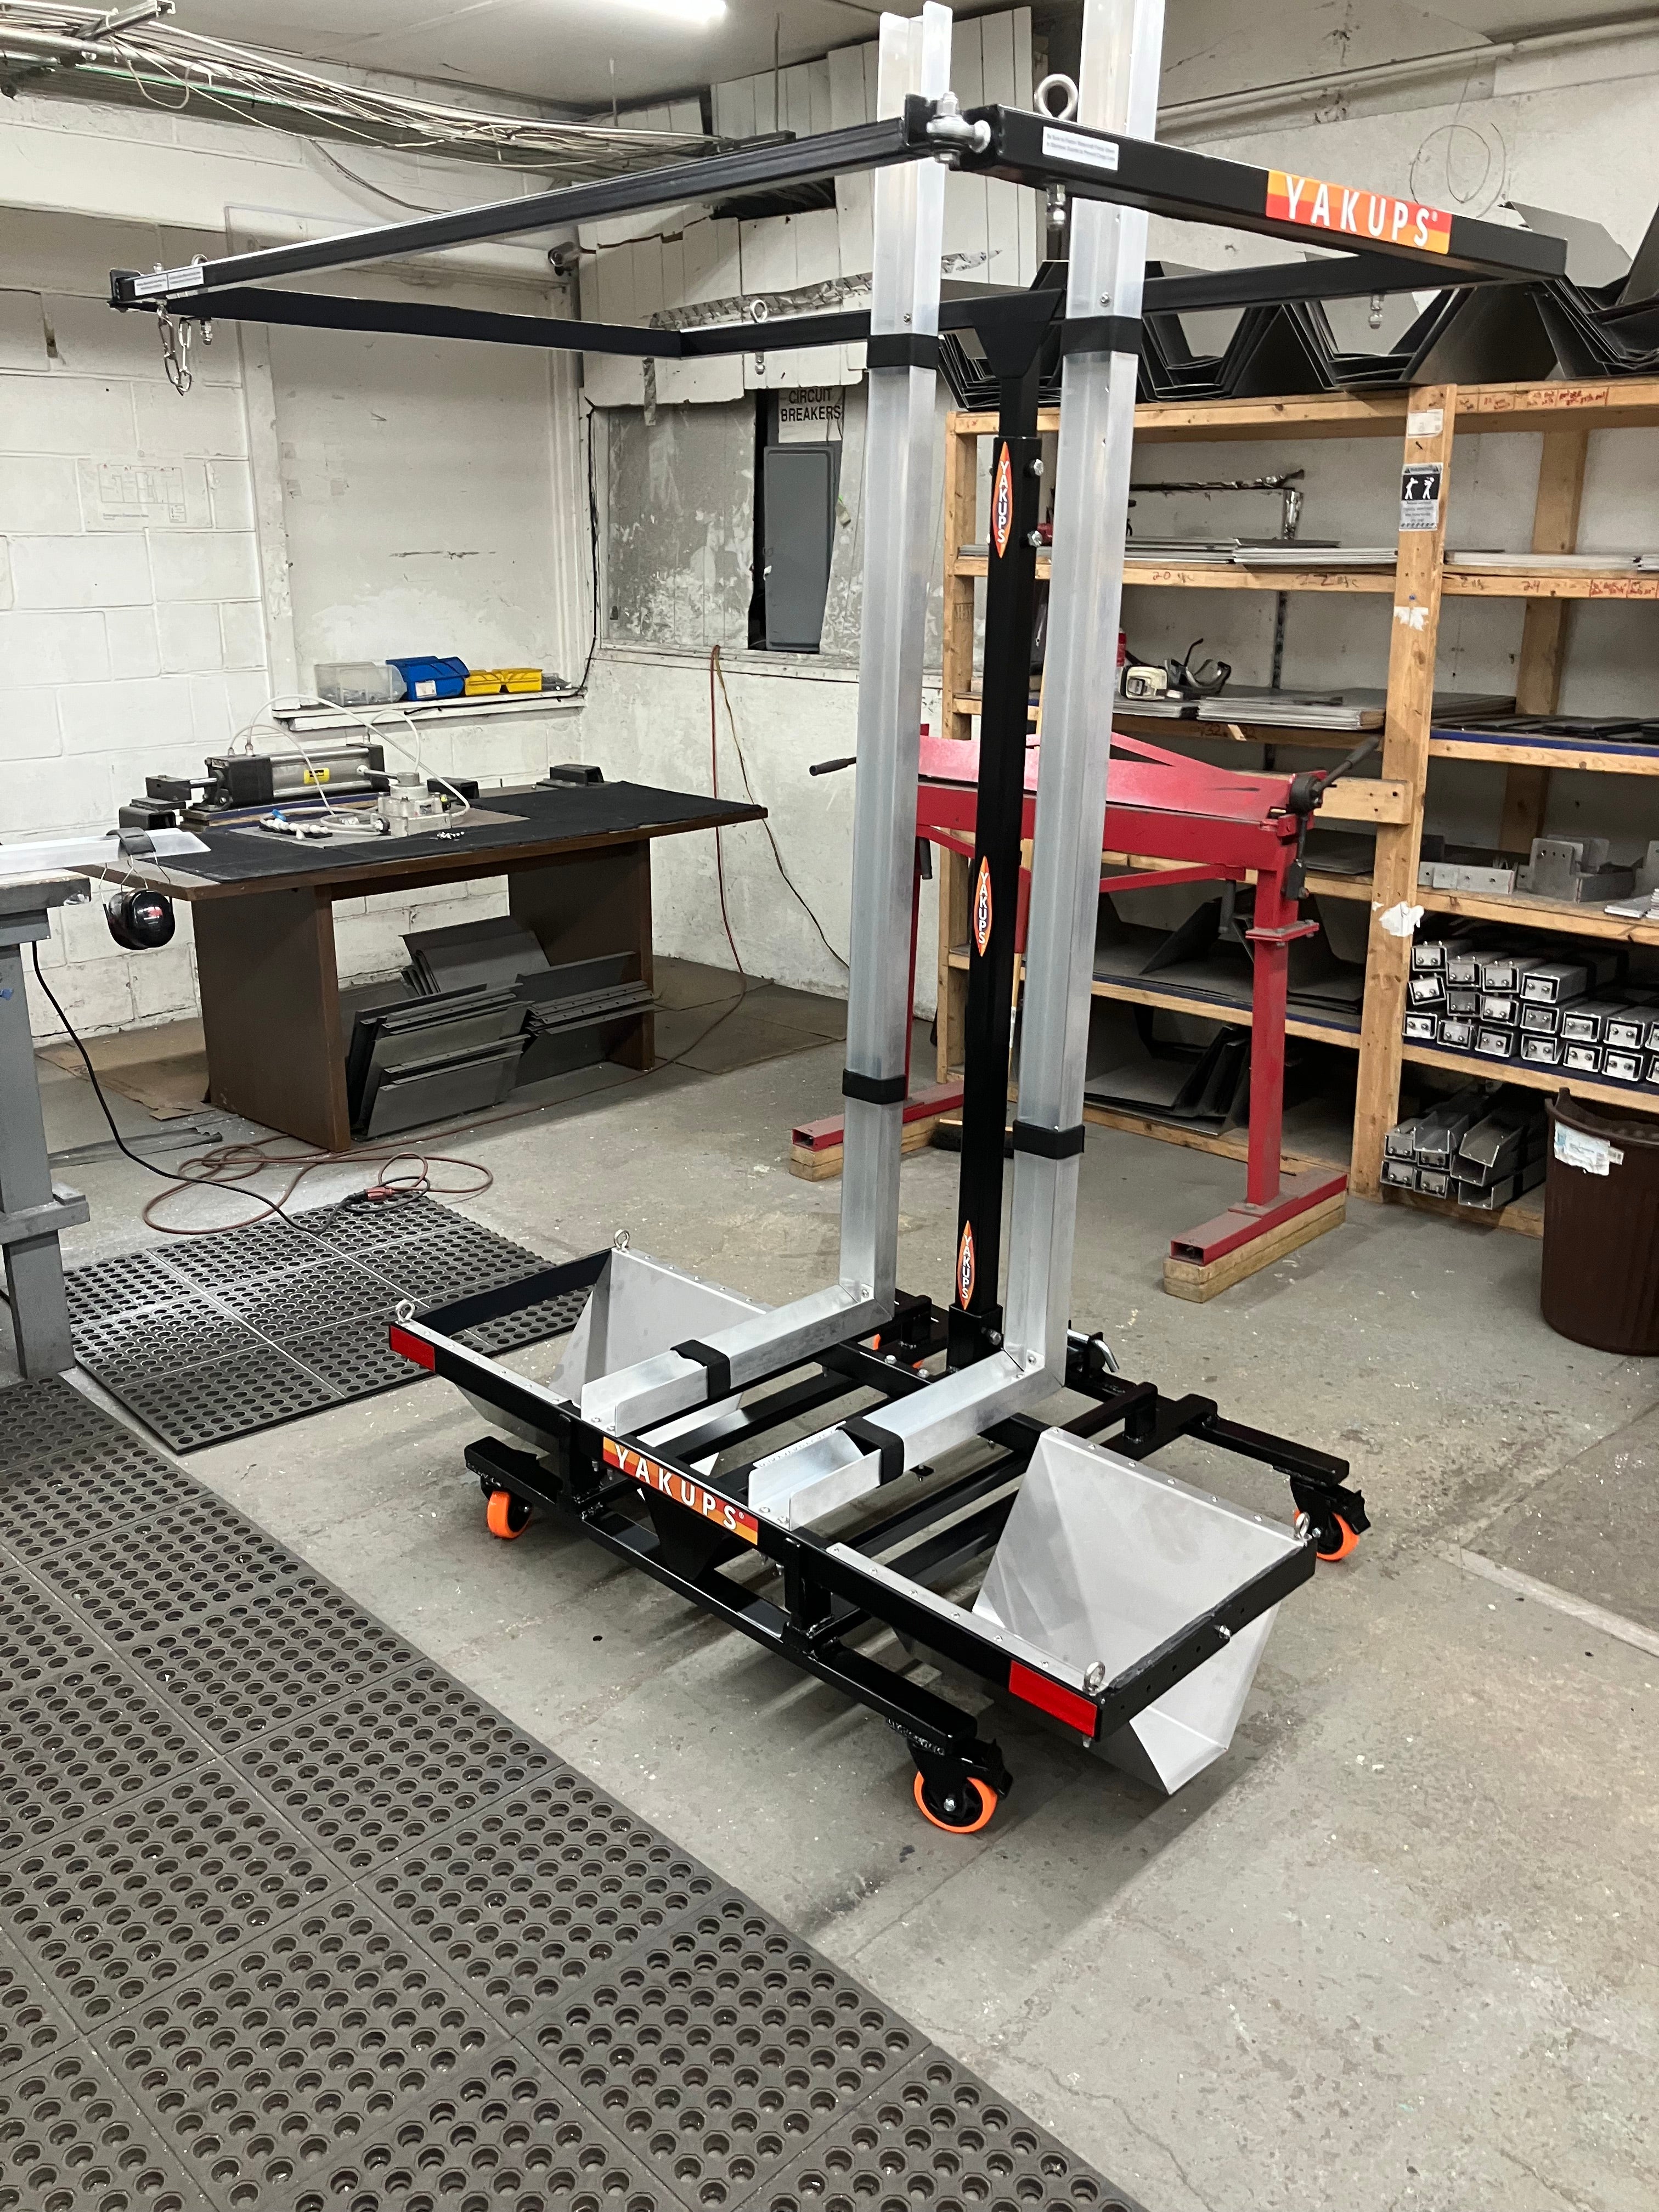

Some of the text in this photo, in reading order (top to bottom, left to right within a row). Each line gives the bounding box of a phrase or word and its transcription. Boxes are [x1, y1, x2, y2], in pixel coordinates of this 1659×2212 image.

[781, 405, 841, 422] BREAKERS
[789, 387, 833, 404] CIRCUIT
[997, 460, 1009, 543] YAKUPS
[978, 871, 989, 944] YAKUPS
[962, 1233, 972, 1299] YAKUPS
